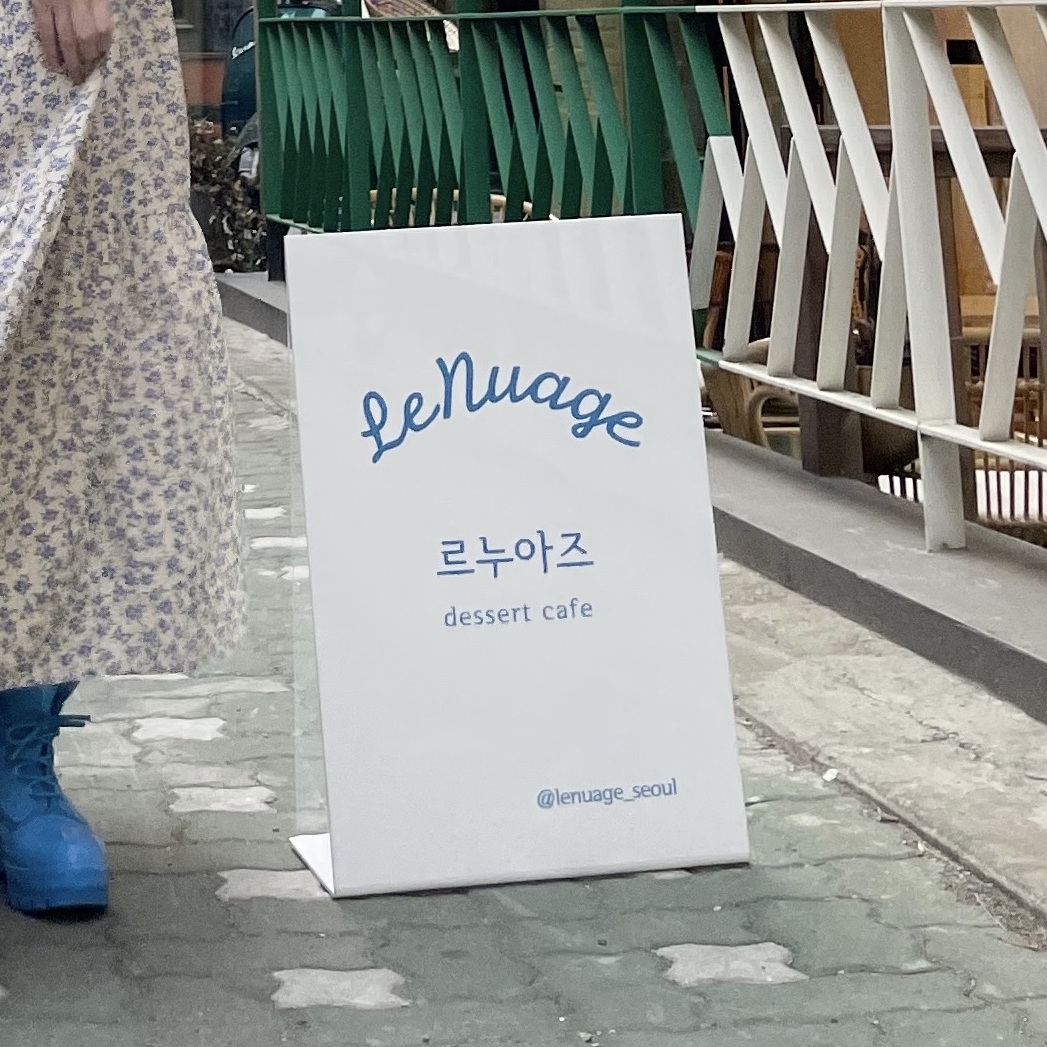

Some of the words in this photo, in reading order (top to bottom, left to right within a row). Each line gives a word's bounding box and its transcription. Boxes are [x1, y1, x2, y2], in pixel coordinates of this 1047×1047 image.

[437, 530, 594, 578] 르누아즈
[443, 606, 532, 627] dessert
[542, 597, 593, 621] cafe
[537, 777, 678, 809] @lenuage_seoul
